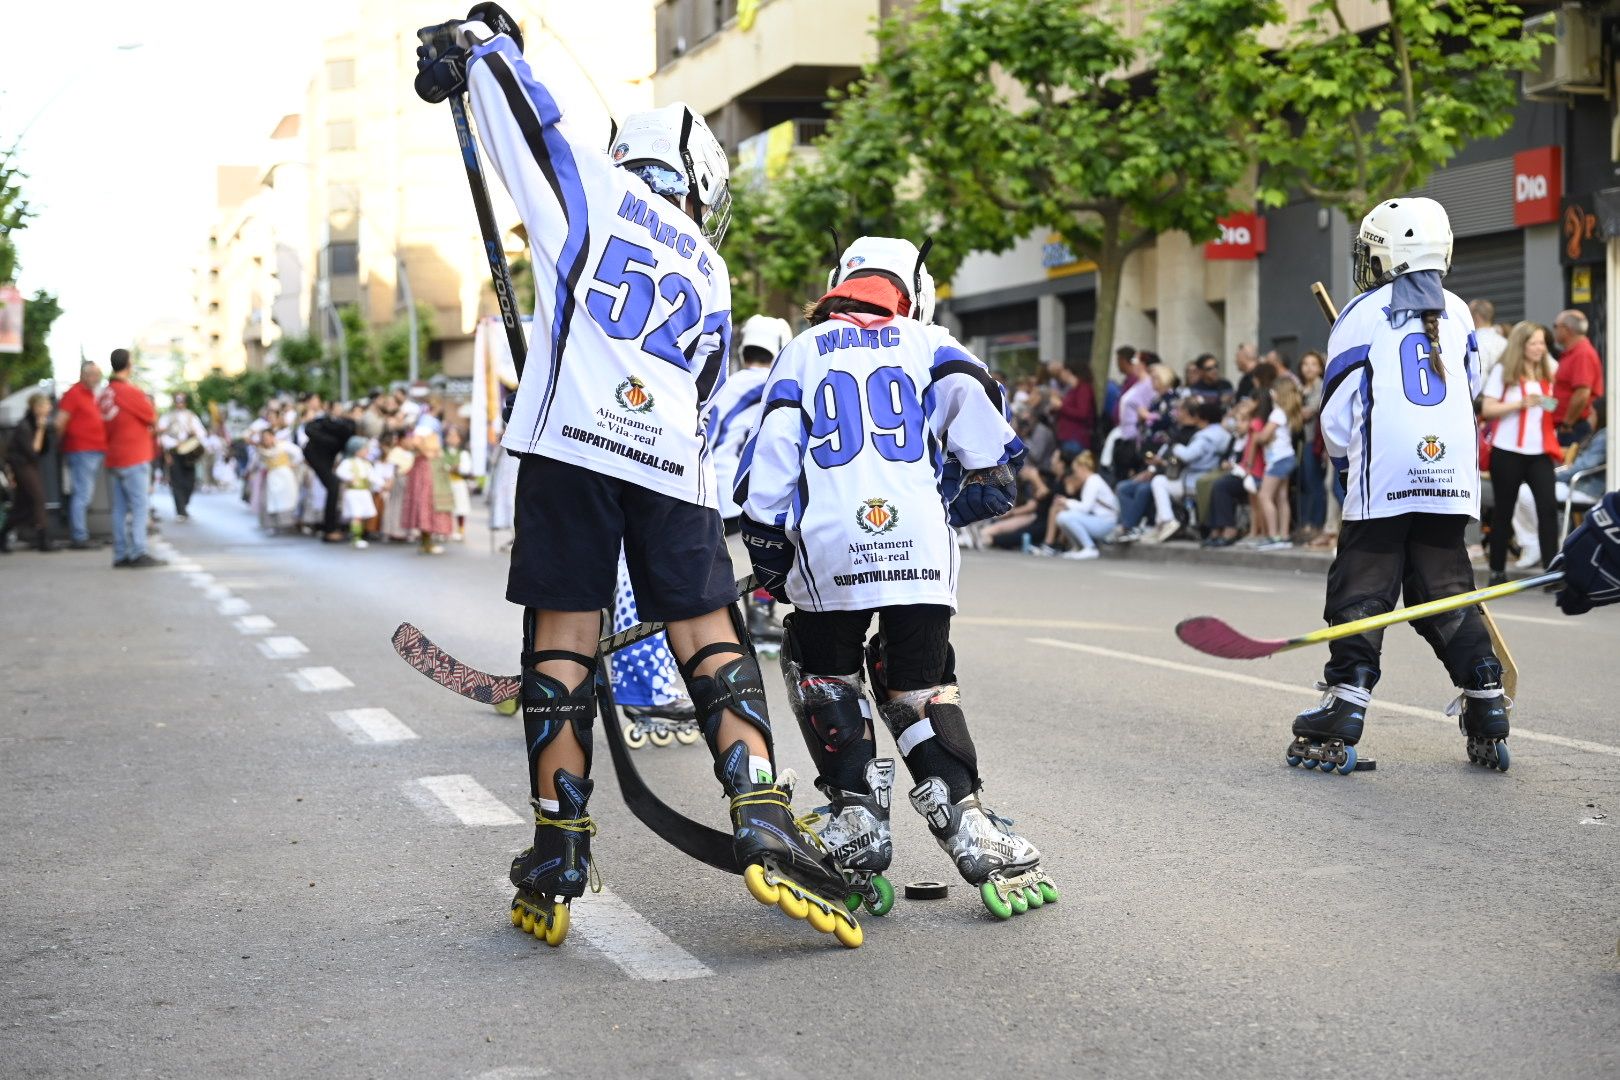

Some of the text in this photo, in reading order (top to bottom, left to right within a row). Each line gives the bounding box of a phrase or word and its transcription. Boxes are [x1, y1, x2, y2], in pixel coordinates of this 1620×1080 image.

[617, 190, 697, 260] MARC
[585, 234, 703, 373] 52
[815, 326, 900, 356] MARC
[1399, 332, 1447, 406] 6
[596, 407, 664, 436] Ajuntament
[810, 365, 925, 469] 99
[597, 420, 656, 446] de Vila-real
[562, 425, 685, 477] CLUBPATIVILAREAL.COM
[1407, 467, 1455, 476] Ajuntament
[1418, 476, 1453, 484] Vila-real
[848, 539, 914, 555] Ajuntament
[853, 551, 910, 566] de Vila-real
[967, 836, 1014, 859] MISSION
